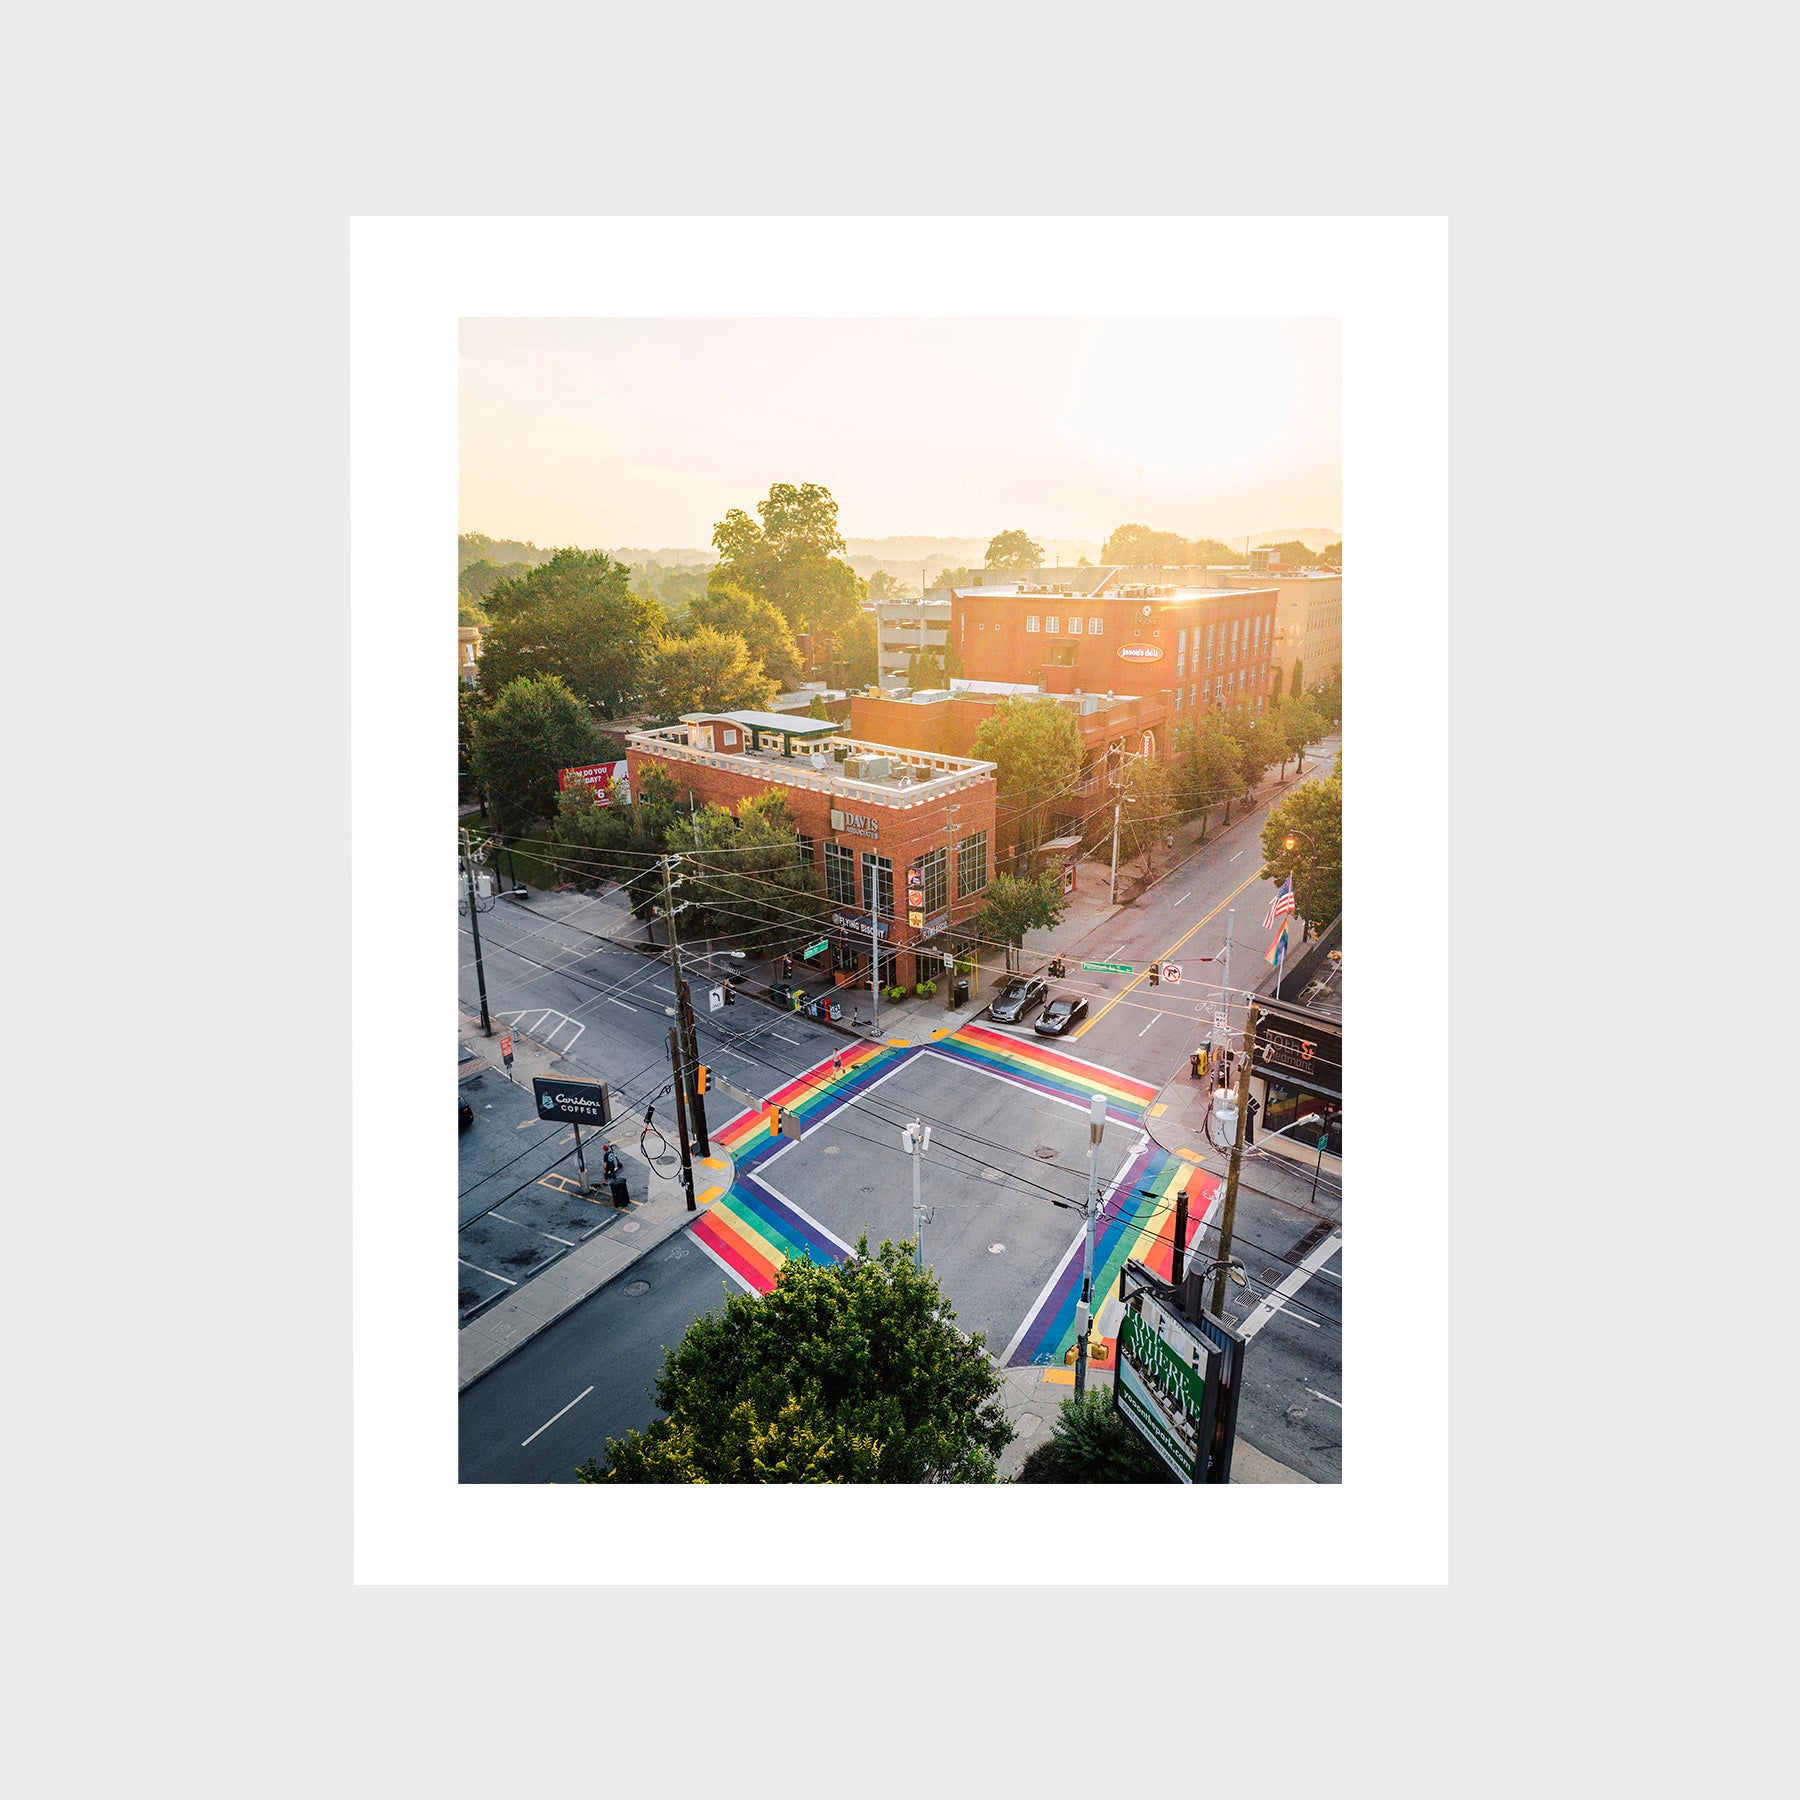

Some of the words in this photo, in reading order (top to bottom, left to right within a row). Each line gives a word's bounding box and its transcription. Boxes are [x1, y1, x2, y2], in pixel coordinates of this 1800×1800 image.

[1145, 649, 1158, 657] deli
[594, 767, 607, 775] YOU
[845, 812, 878, 832] DAVIS
[840, 917, 859, 930] FLYING
[861, 924, 885, 938] BISCIT
[555, 1094, 600, 1107] Caribou
[561, 1105, 597, 1115] COFFEE
[1126, 1303, 1162, 1349] LOVE
[1133, 1324, 1188, 1393] WHERE
[1131, 1336, 1159, 1377] YOO
[1165, 1374, 1200, 1422] LIVE
